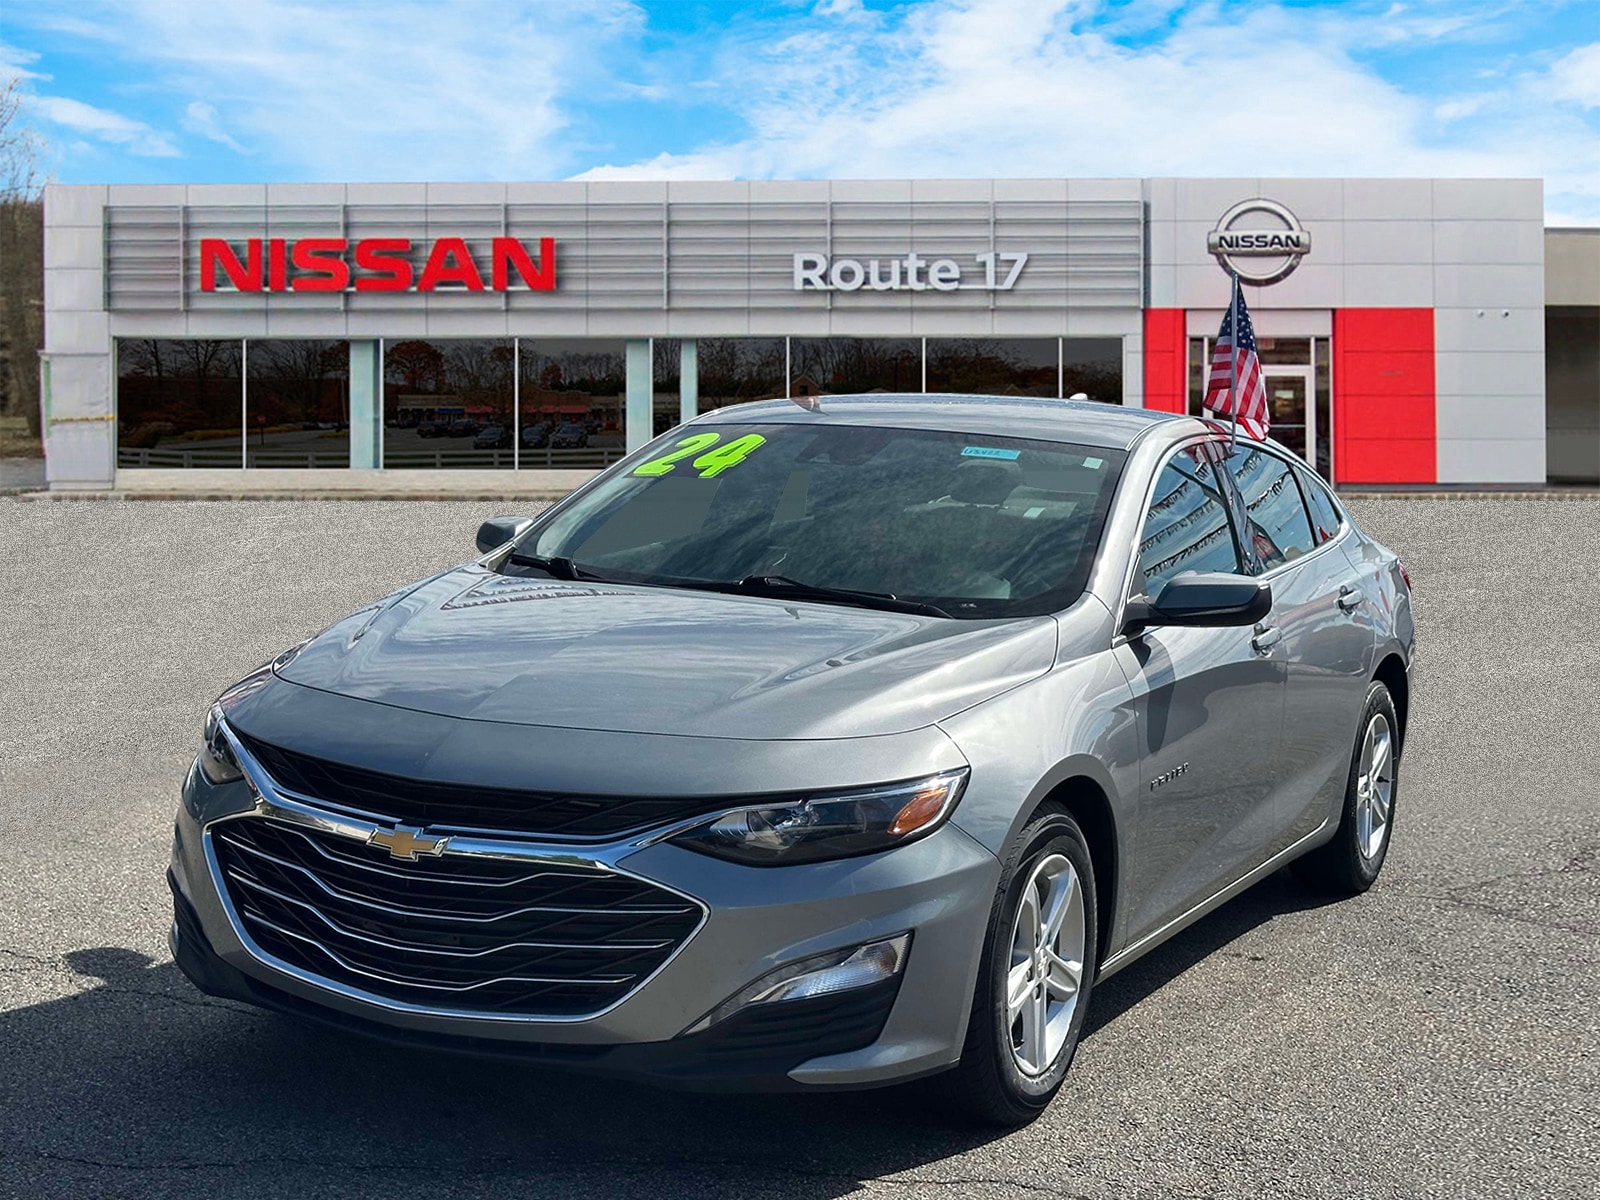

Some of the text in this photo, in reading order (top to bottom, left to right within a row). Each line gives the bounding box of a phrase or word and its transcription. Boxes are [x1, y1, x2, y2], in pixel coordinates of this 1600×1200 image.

[1218, 234, 1300, 249] NISSAN
[200, 237, 556, 292] NISSAN
[793, 251, 1029, 291] Route 17
[632, 432, 768, 479] 24
